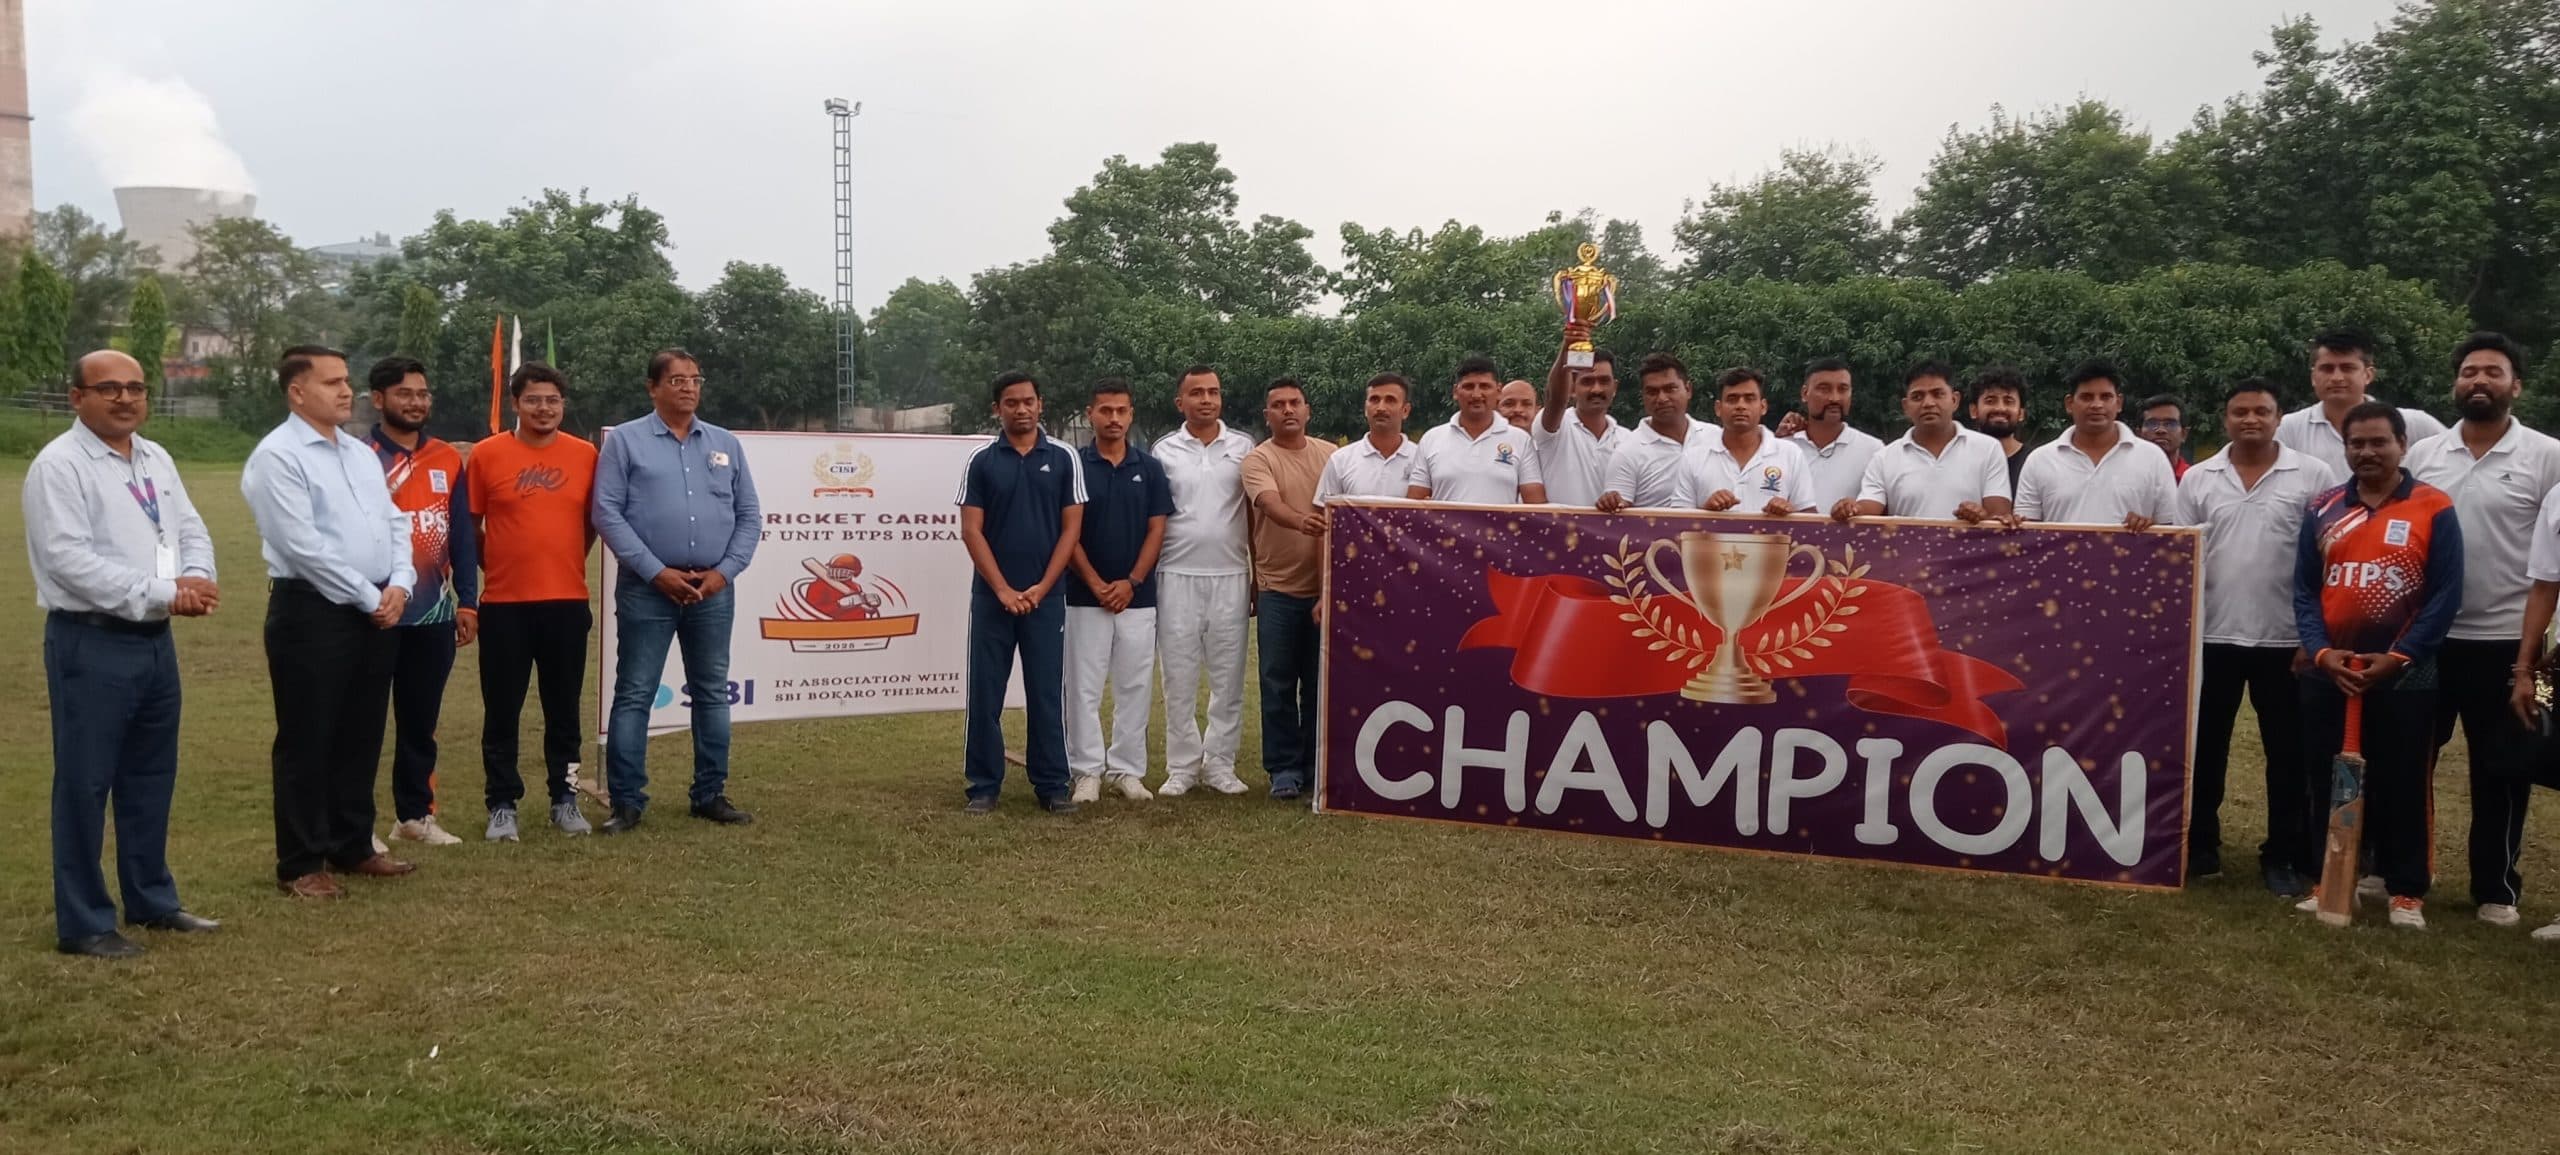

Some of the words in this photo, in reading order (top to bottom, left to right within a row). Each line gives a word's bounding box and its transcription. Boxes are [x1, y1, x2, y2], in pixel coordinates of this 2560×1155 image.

[830, 465, 858, 473] CISF
[401, 510, 448, 534] TPS
[760, 513, 866, 525] RICKET
[878, 513, 957, 525] CARNI
[780, 530, 834, 541] UNIT
[842, 530, 894, 541] BTPS
[902, 530, 961, 541] BOKA
[2327, 562, 2404, 590] BTPS
[775, 680, 793, 688] IN
[800, 674, 912, 687] ASSOCIATION
[918, 672, 960, 682] WITH
[775, 691, 801, 702] SBI
[808, 689, 876, 700] BOKARO
[881, 686, 960, 697] THERMAL
[1354, 700, 2147, 866] CHAMPION
